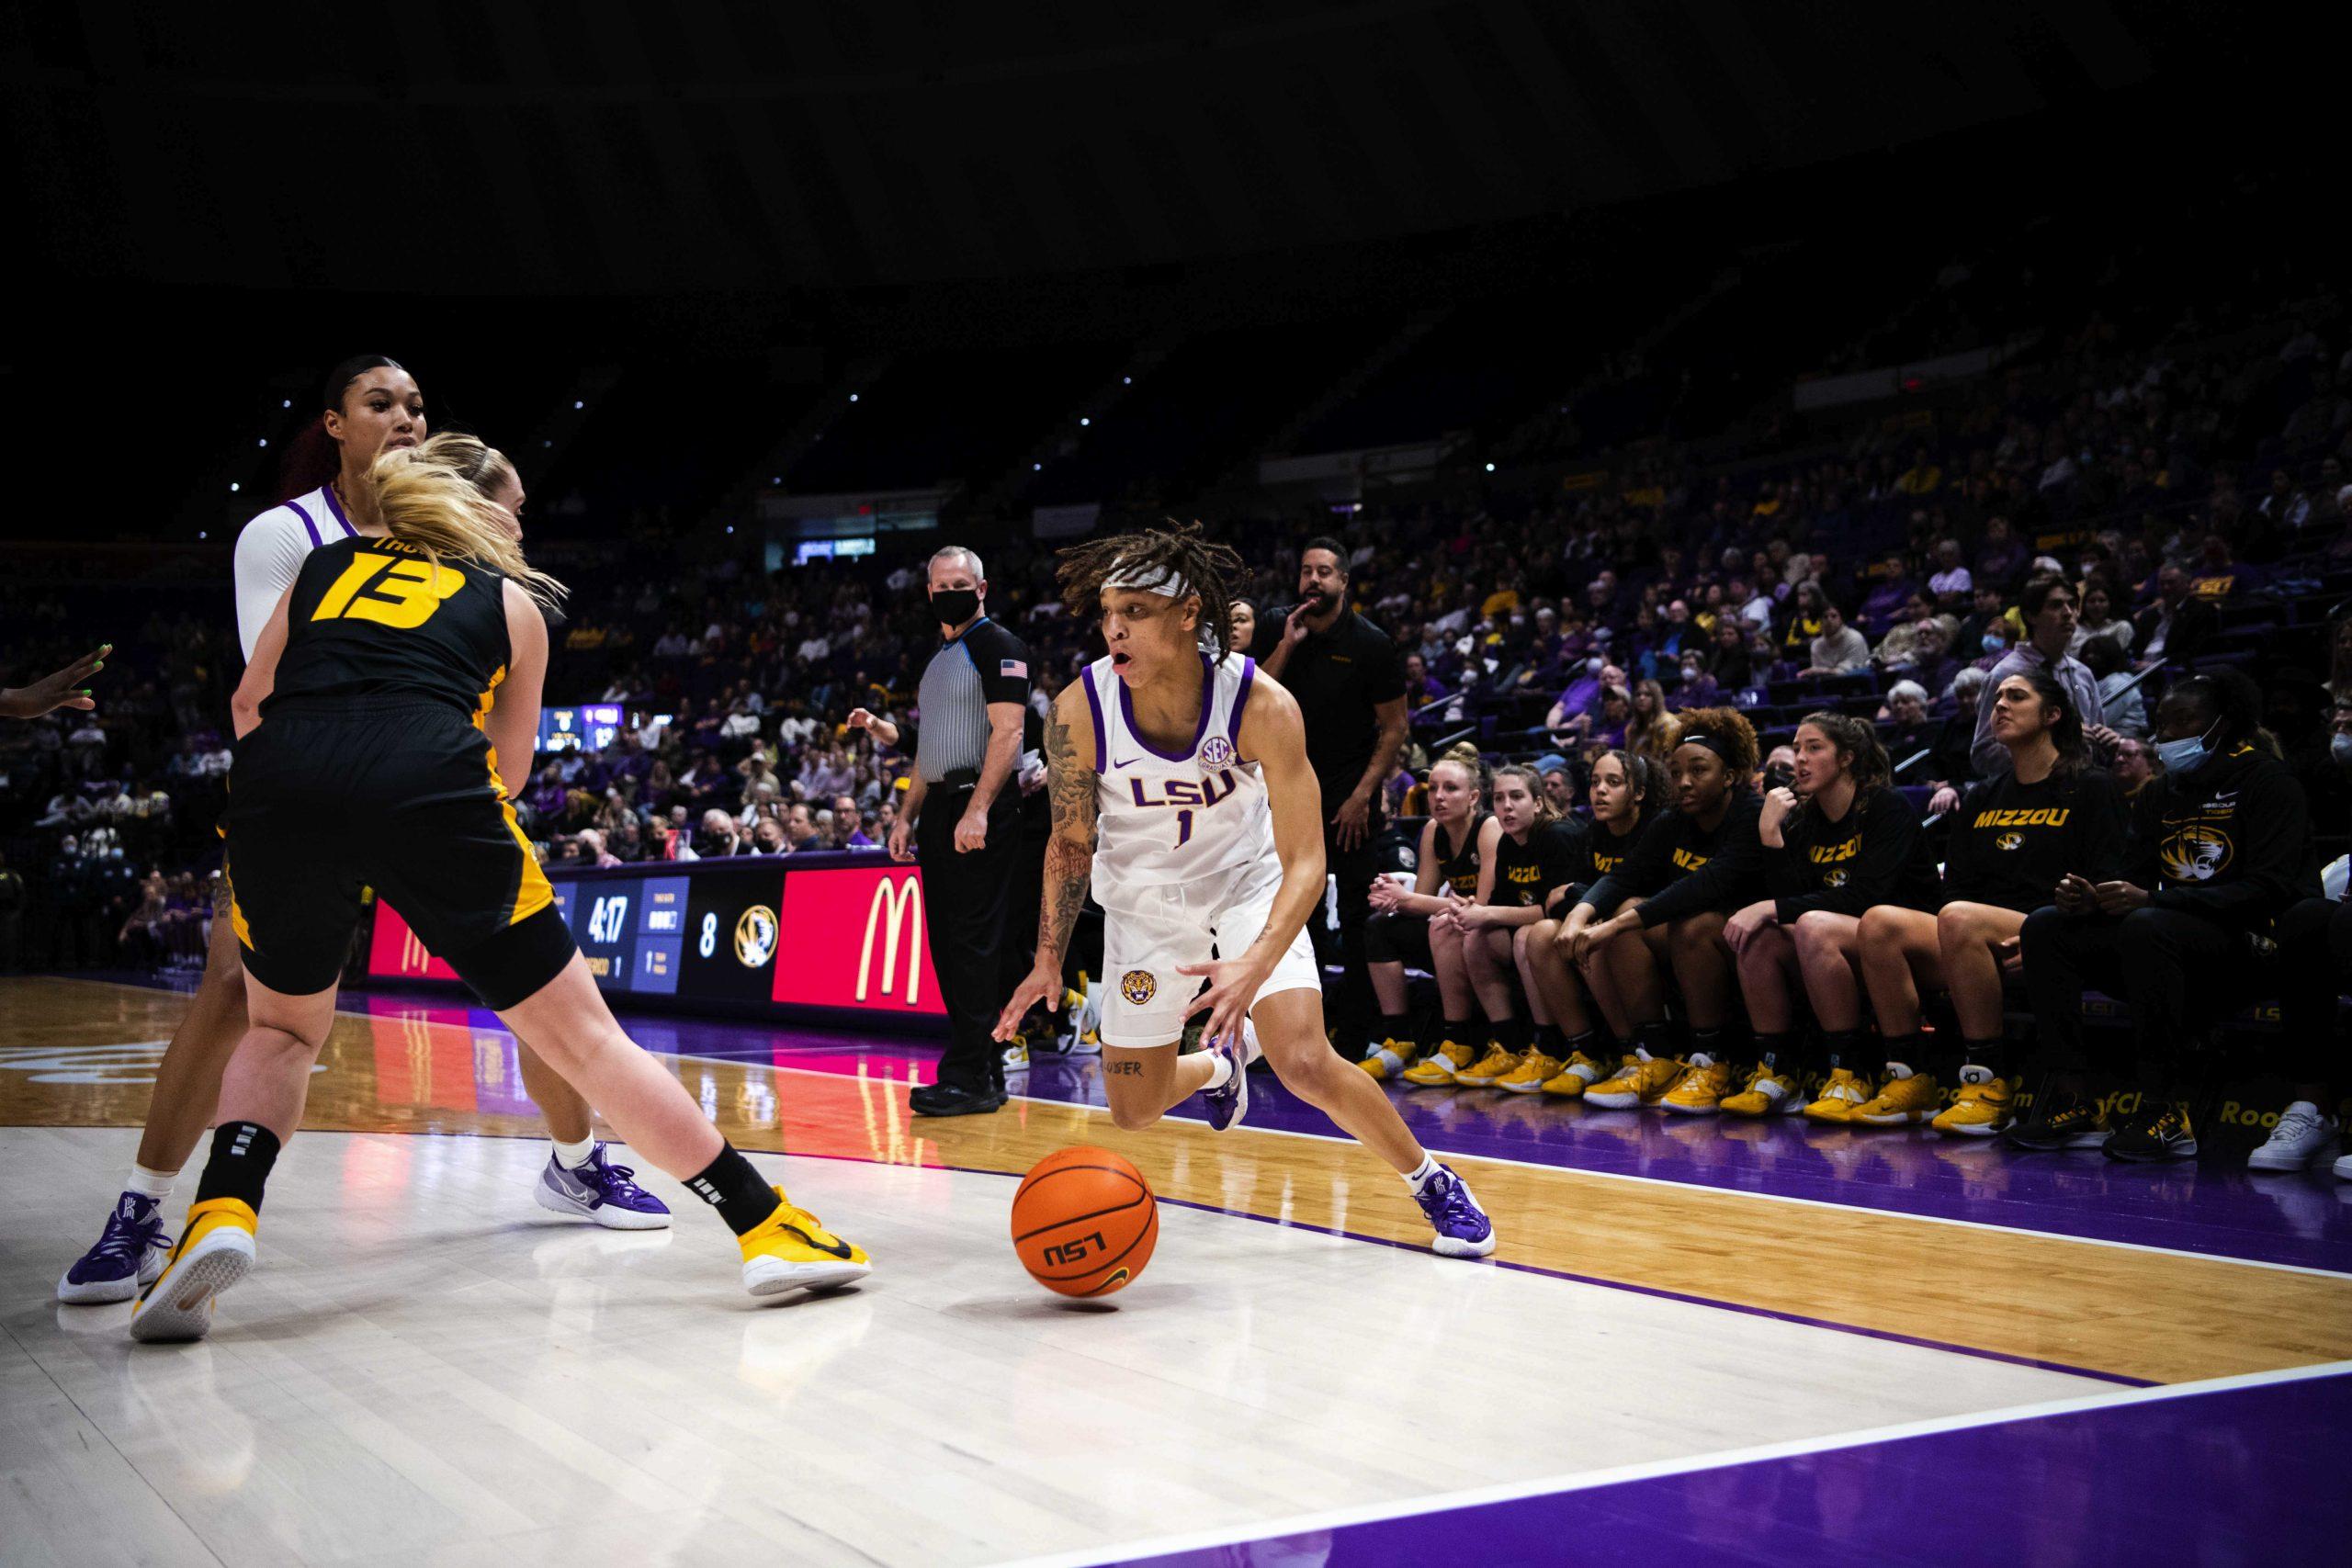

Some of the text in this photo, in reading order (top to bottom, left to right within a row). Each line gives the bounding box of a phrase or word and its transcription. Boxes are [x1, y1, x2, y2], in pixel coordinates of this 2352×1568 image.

[310, 551, 467, 629] 13
[1204, 738, 1230, 763] SEC
[1130, 769, 1237, 807] LSU
[1173, 809, 1193, 851] 1
[1973, 808, 2071, 829] MIZZOU
[589, 896, 628, 943] 4:17
[700, 913, 717, 958] 8
[615, 955, 622, 978] 1
[2253, 1006, 2282, 1023] LS
[1044, 1231, 1107, 1268] LSU
